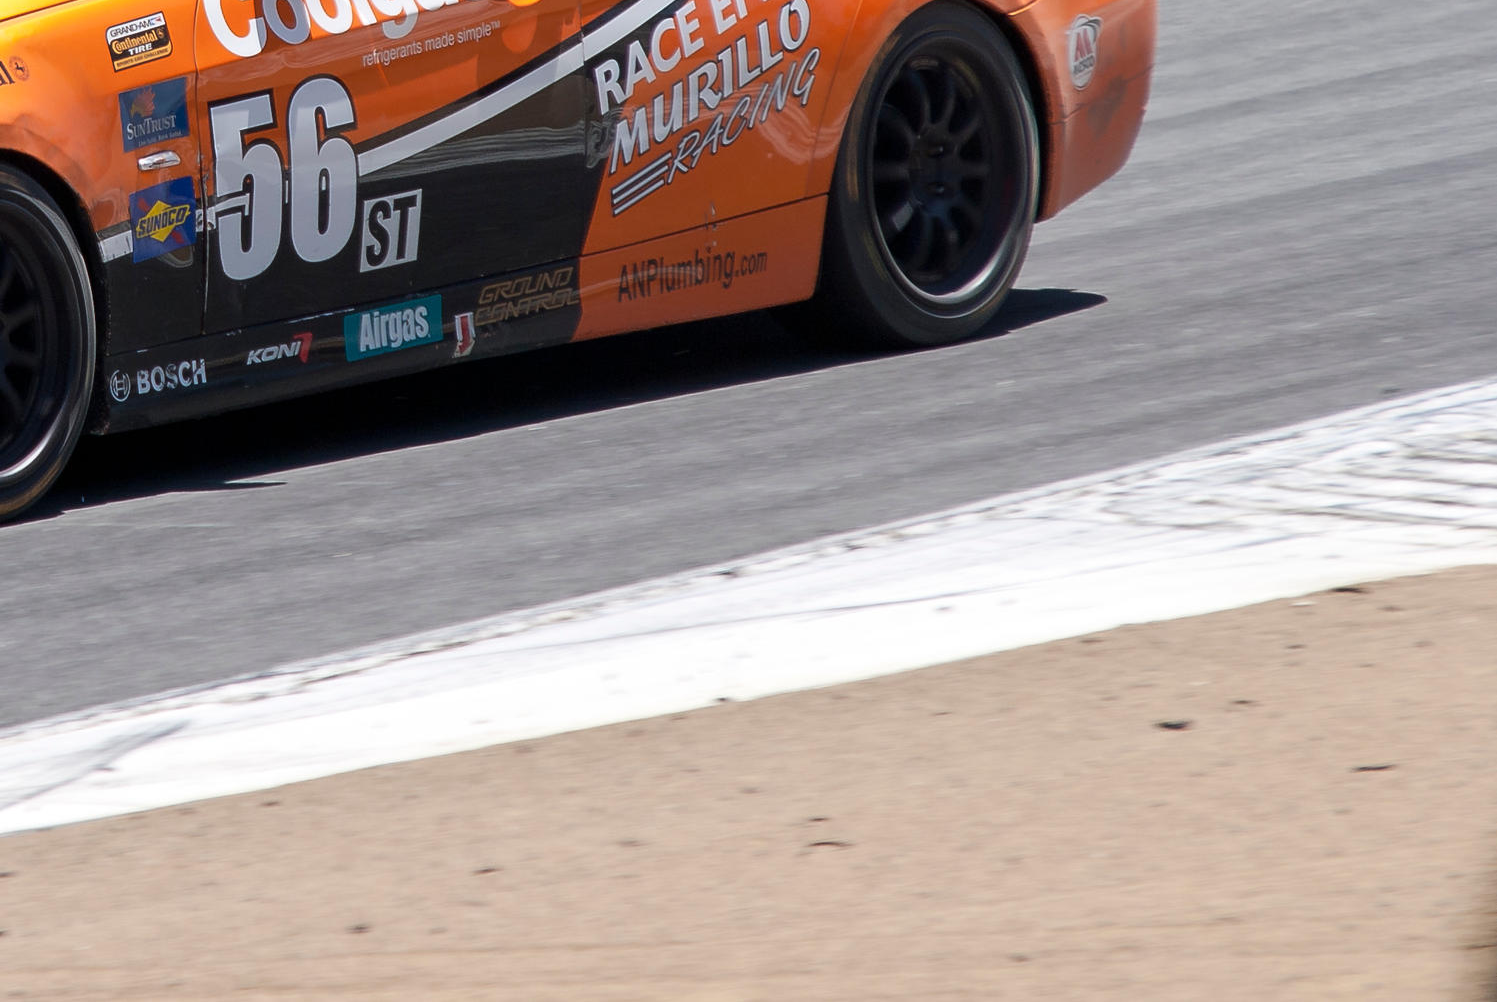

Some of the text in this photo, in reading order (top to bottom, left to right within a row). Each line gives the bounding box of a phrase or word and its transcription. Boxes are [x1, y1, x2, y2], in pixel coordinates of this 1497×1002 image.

[111, 29, 159, 55] Continental
[128, 42, 153, 56] TIRE
[362, 41, 423, 67] refrigerants
[425, 33, 455, 51] made
[595, 1, 704, 115] RACE
[666, 48, 821, 185] RACING
[208, 75, 358, 282] 56
[136, 203, 190, 238] SUNOCO
[362, 195, 418, 267] ST
[479, 266, 574, 304] GROUND
[617, 247, 768, 303] ANPlumbing.com
[475, 288, 580, 327] CONTROL
[360, 306, 429, 352] Airgas
[247, 341, 302, 365] KONI
[136, 359, 207, 395] BOSCH
